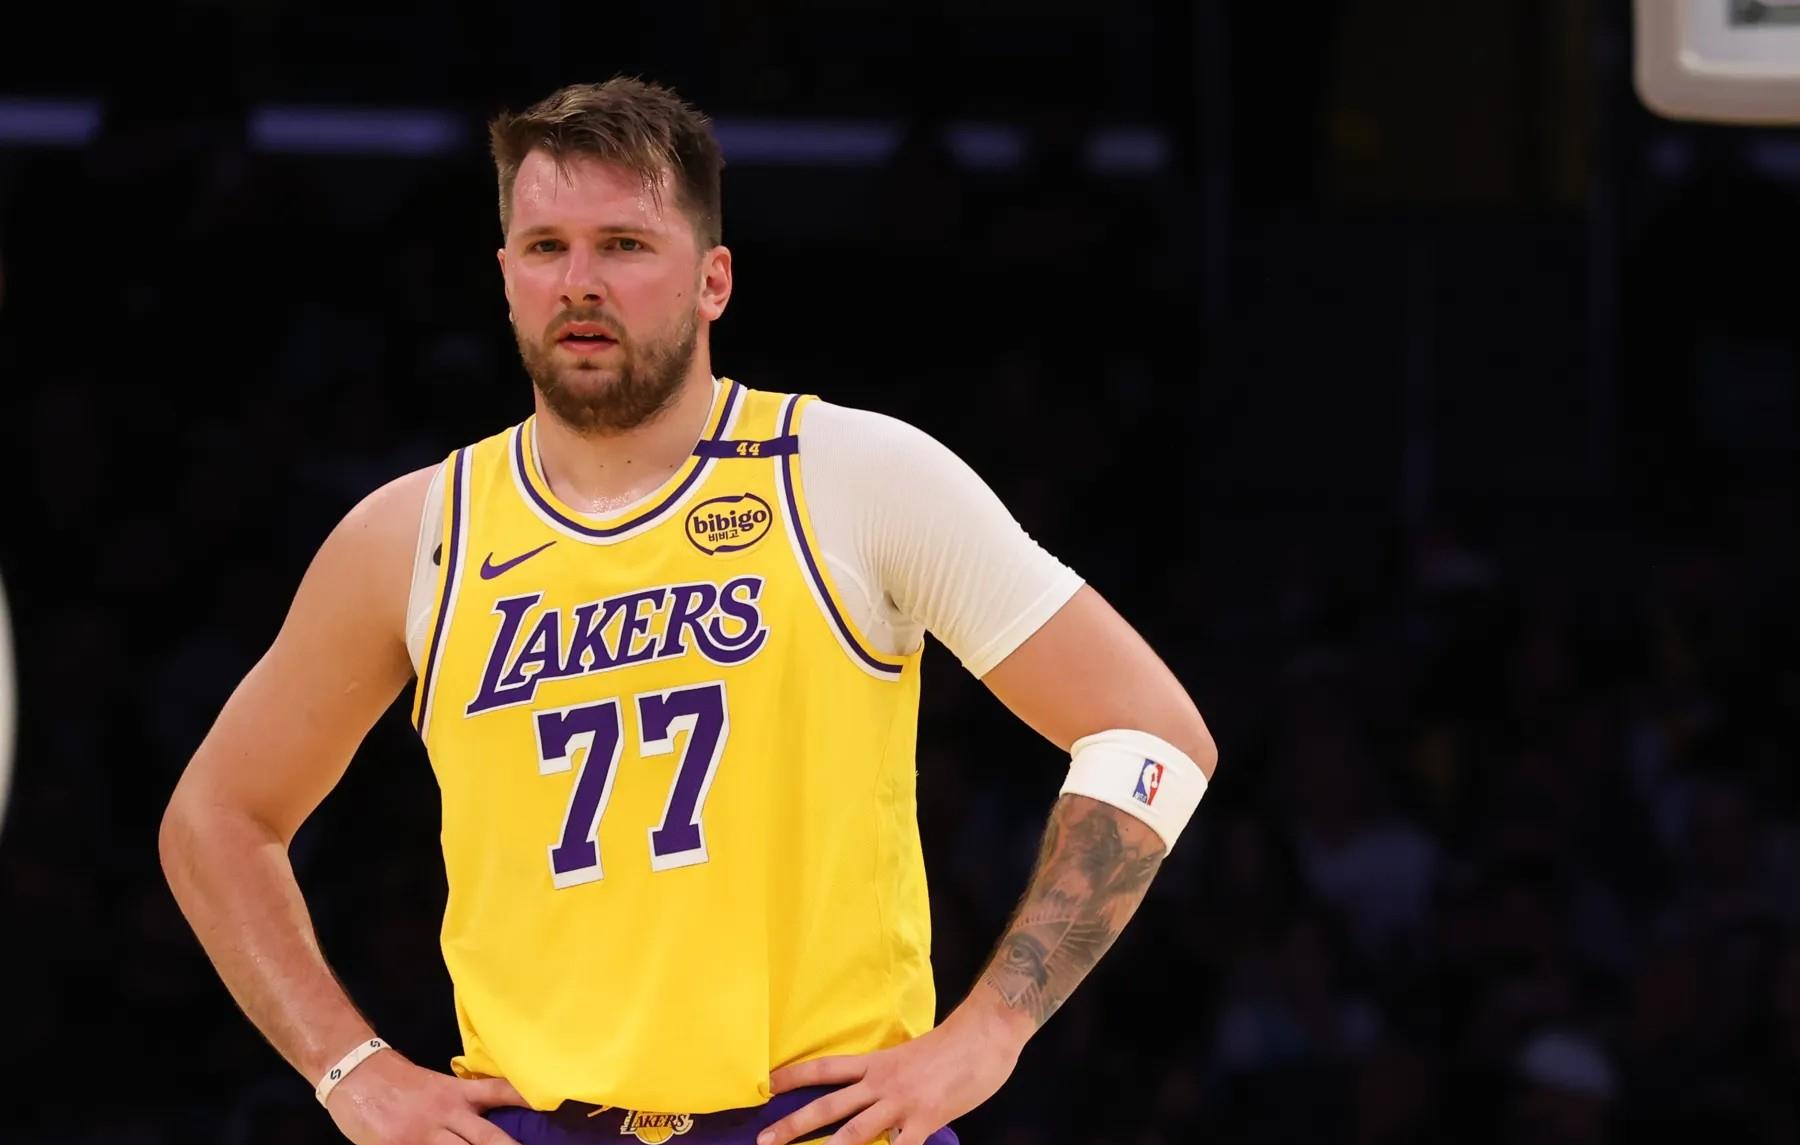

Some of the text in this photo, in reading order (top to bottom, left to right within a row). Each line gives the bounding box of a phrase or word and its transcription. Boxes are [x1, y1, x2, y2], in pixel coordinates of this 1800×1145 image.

[736, 442, 761, 456] 44
[693, 508, 767, 532] bibigo
[708, 529, 740, 542] 비비고
[466, 576, 770, 717] LAKERS
[534, 681, 729, 889] 77
[620, 1110, 694, 1135] LAKERS
